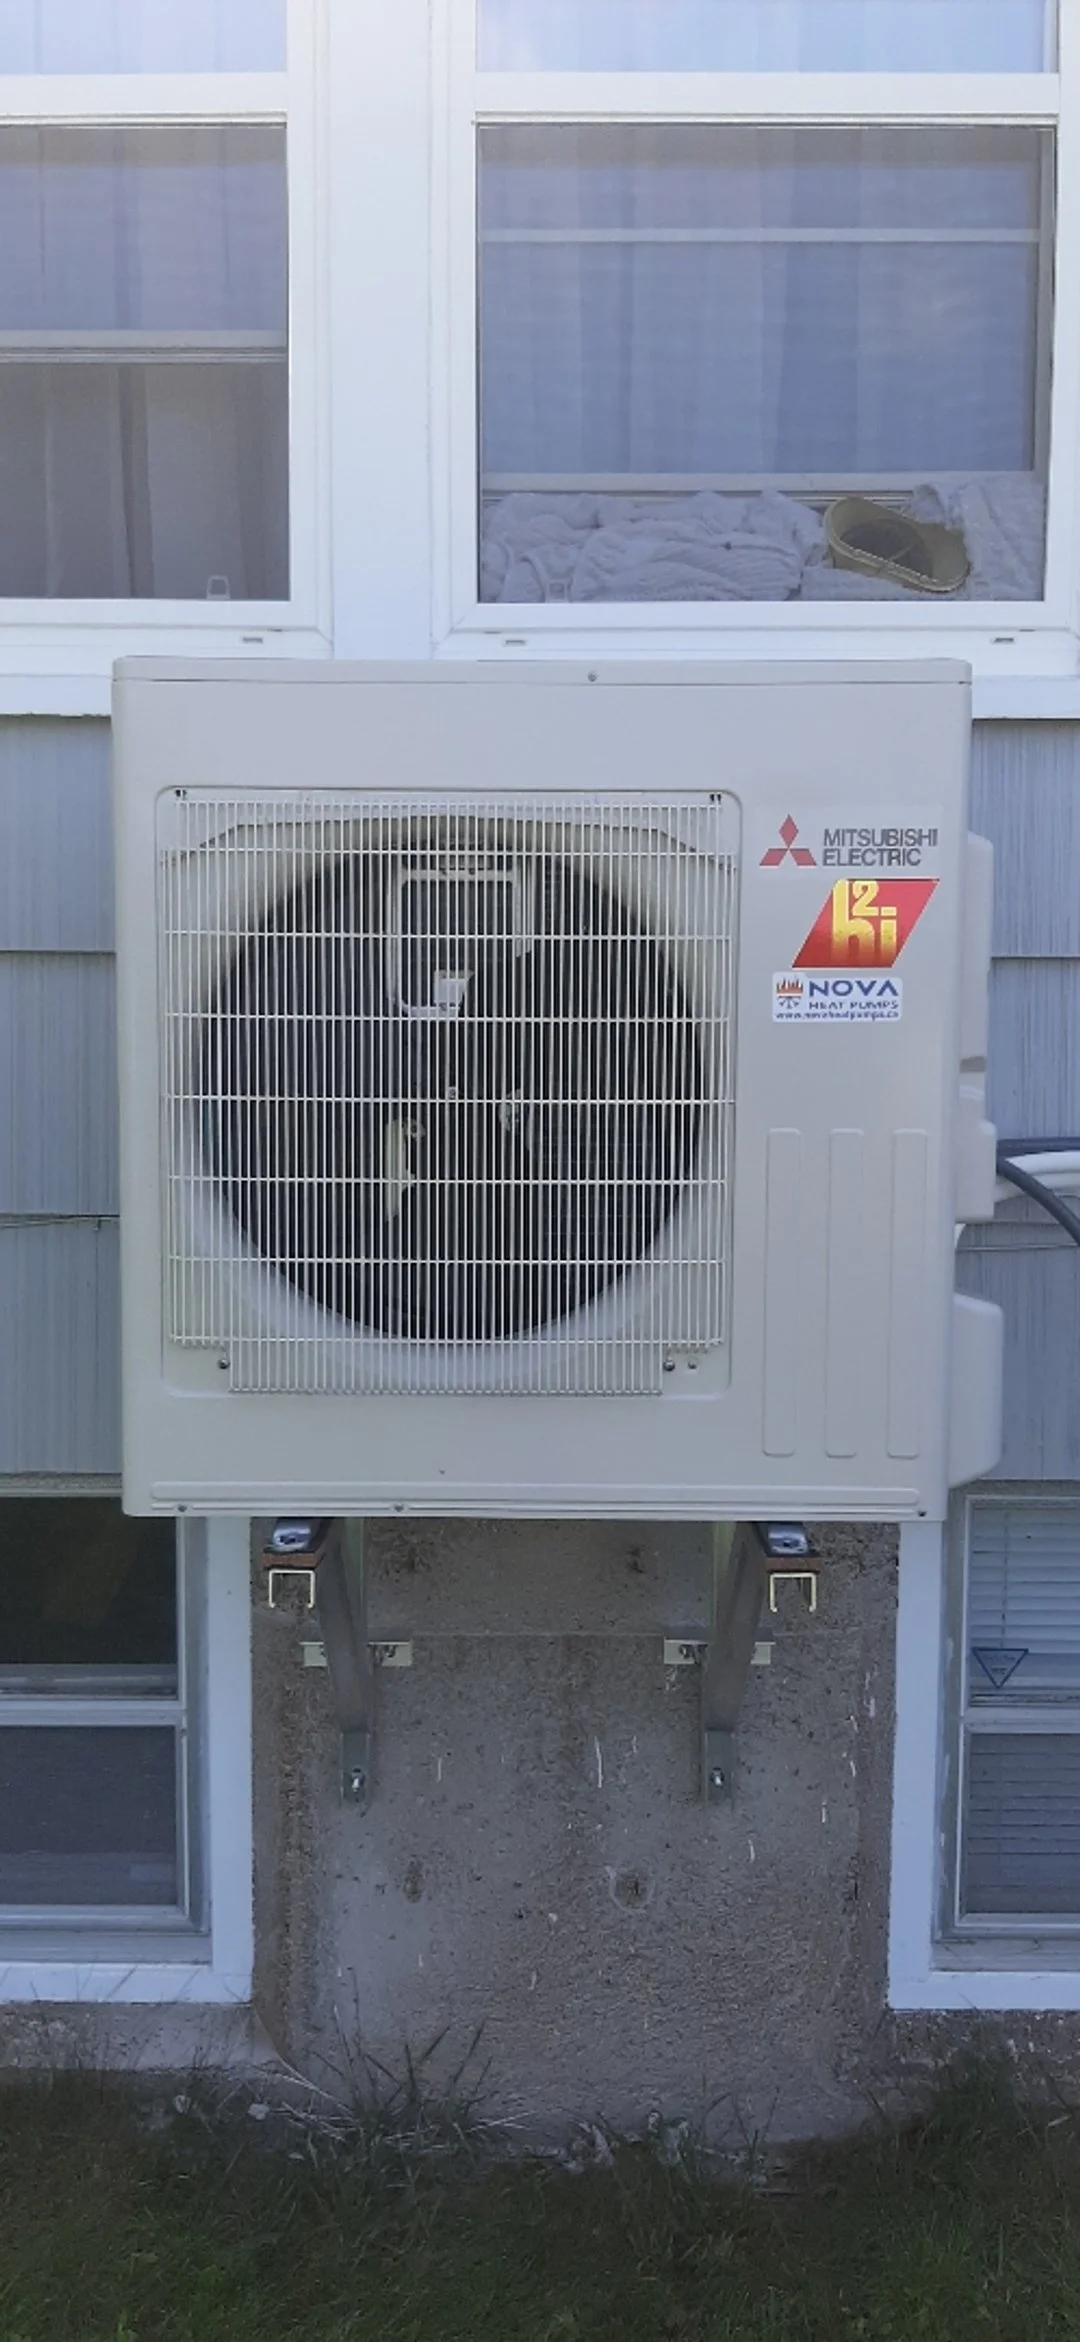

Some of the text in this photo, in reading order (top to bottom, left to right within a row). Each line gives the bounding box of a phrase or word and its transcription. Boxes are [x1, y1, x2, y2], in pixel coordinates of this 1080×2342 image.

[823, 829, 938, 847] MITSUBISHI
[823, 849, 921, 866] ELECTRIC
[809, 980, 898, 997] NOVA
[809, 1000, 898, 1010] HEAT PUMPS
